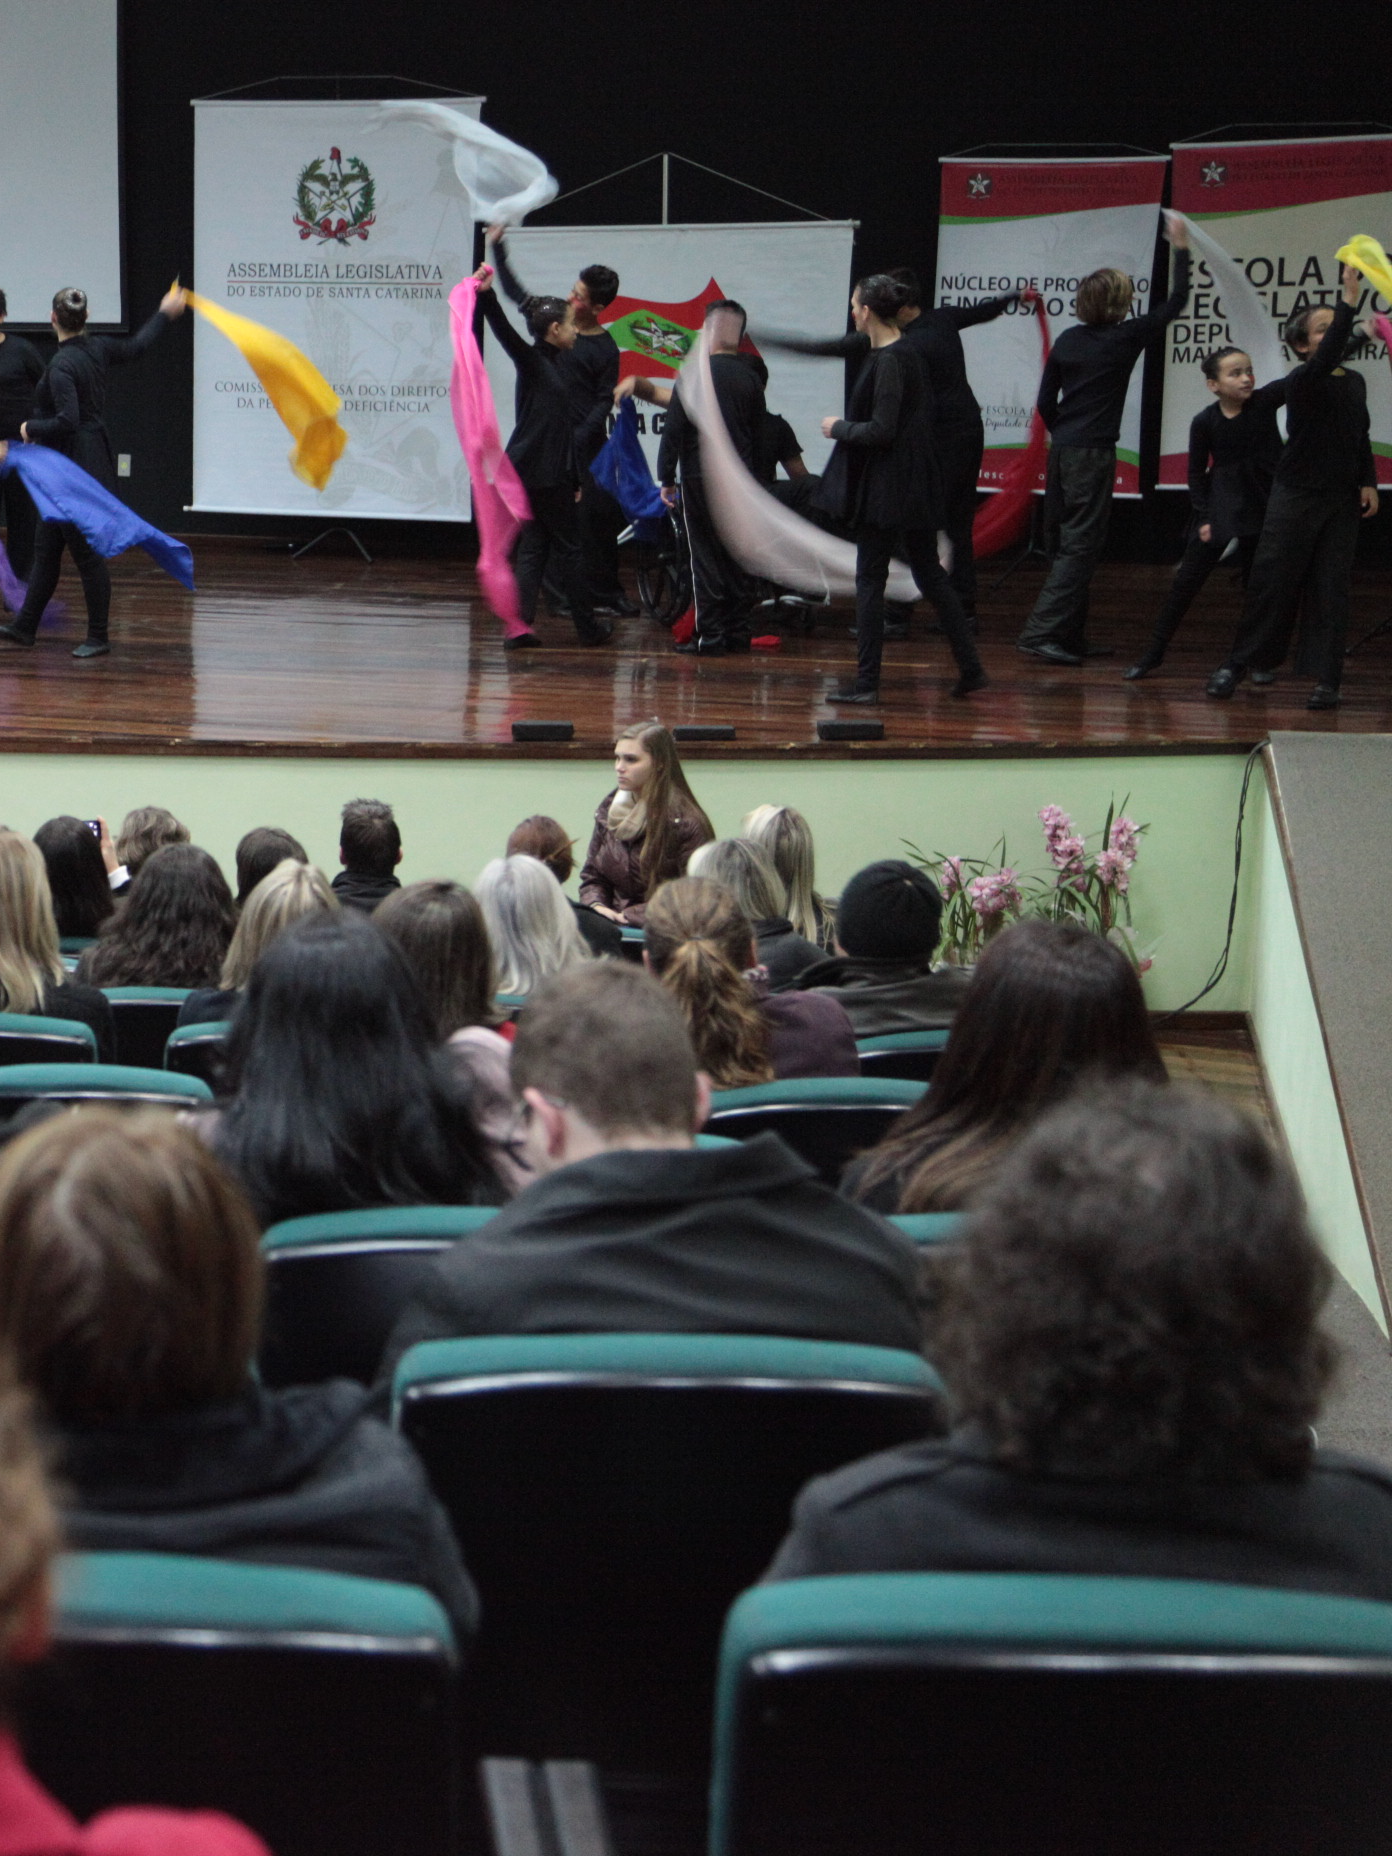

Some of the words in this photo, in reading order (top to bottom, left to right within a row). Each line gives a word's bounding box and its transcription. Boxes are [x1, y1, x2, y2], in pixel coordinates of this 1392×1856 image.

[226, 262, 330, 279] ASSEMBLEIA
[335, 263, 443, 280] LEGISLATIVA
[940, 273, 1011, 291] NÚCLEO
[1015, 277, 1038, 292] DE
[226, 285, 246, 297] DO
[249, 286, 302, 298] ESTADO
[306, 286, 324, 298] DE
[328, 287, 371, 299] SANTA
[375, 287, 443, 299] CATARINA
[358, 384, 386, 396] DOS
[237, 397, 255, 409] DA
[344, 399, 430, 412] DEFICIÊNCIA
